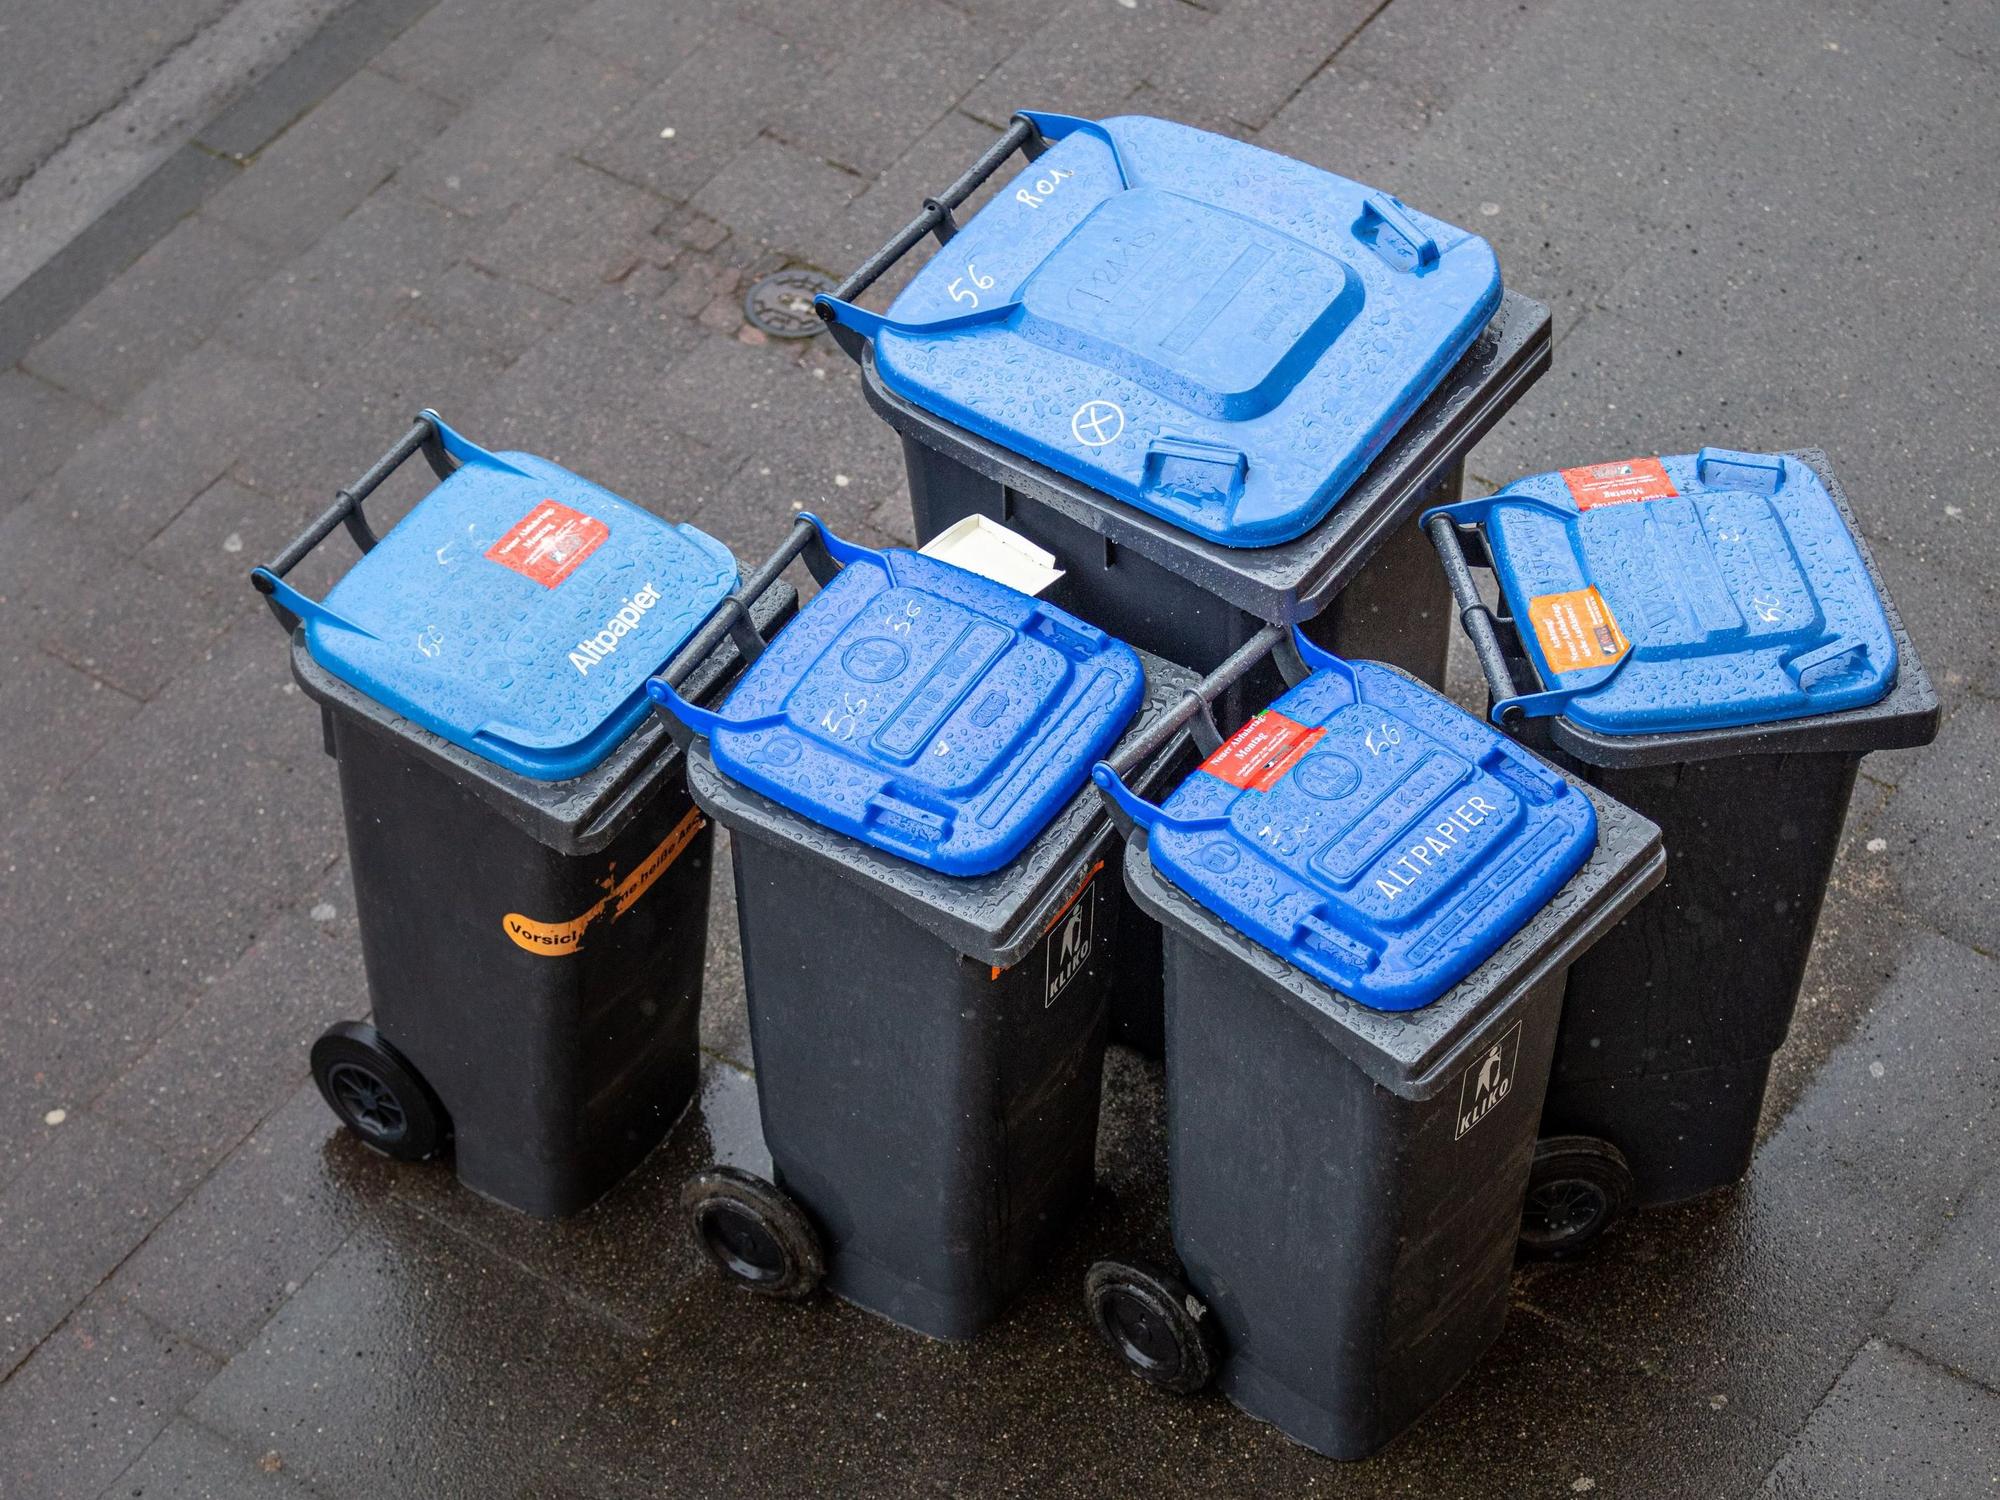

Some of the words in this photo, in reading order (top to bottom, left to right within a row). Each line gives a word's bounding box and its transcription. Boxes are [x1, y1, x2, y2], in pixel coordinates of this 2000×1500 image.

[947, 263, 995, 309] 56
[1602, 487, 1646, 499] Montag
[568, 582, 662, 676] Altpapier
[821, 692, 867, 742] 56
[903, 688, 944, 731] AWB
[1210, 745, 1234, 766] Neuer
[1234, 732, 1268, 760] Montag
[1375, 796, 1497, 900] ALTPAPIER
[1049, 940, 1088, 998] KLIKO
[1460, 1078, 1508, 1134] KLIKO
